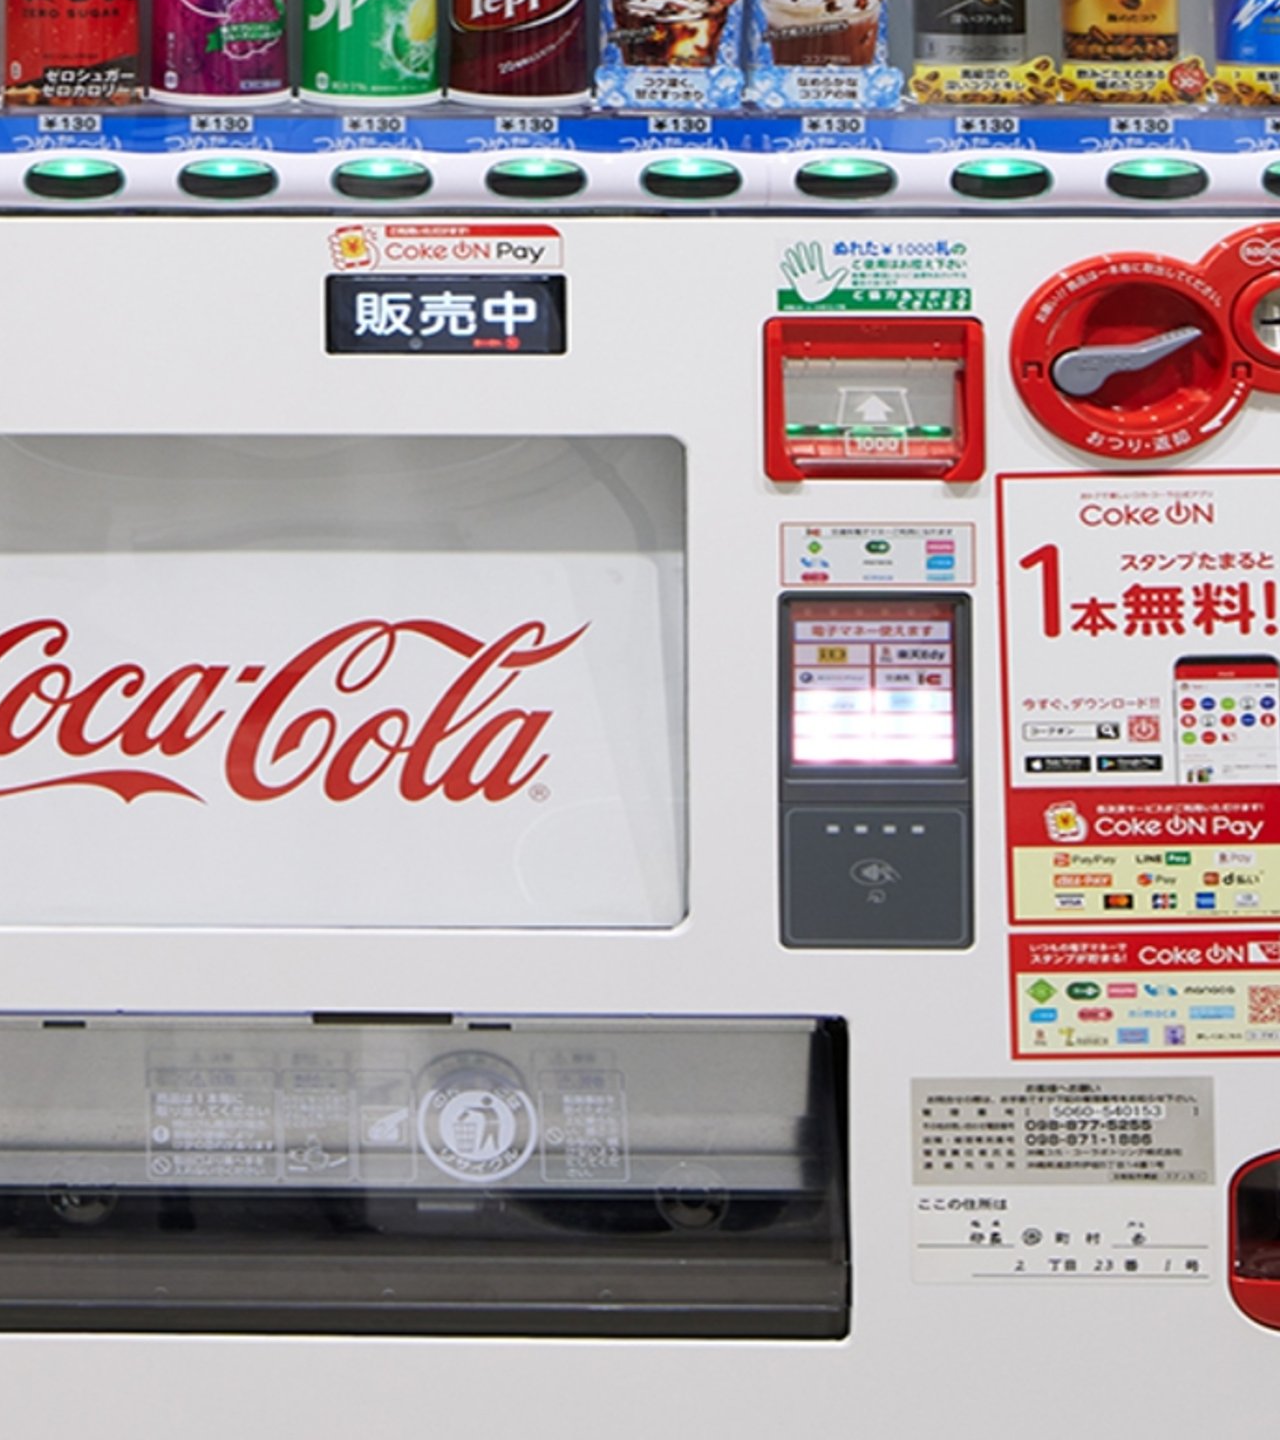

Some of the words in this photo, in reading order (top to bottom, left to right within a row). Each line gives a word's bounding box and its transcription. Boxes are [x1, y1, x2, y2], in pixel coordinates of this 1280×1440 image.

[45, 68, 135, 83] ゼロシュガー
[43, 117, 97, 131] ¥130
[195, 117, 248, 131] ¥130
[348, 118, 400, 132] ¥130
[500, 118, 553, 132] ¥130
[654, 118, 707, 132] ¥130
[806, 118, 860, 132] ¥130
[960, 118, 1014, 132] ¥130
[1115, 118, 1169, 132] ¥130
[385, 241, 448, 260] Coke
[452, 240, 492, 260] ON
[496, 241, 546, 264] Pay
[354, 290, 538, 337] 販売中
[1086, 432, 1192, 453] おつり・返却
[1079, 504, 1160, 526] Coke
[1166, 500, 1214, 525] ON
[1120, 550, 1275, 572] スタンプたまると
[1019, 543, 1279, 639] 1本無料!
[1094, 817, 1162, 836] Coke
[1165, 814, 1207, 835] ON
[1212, 817, 1265, 840] Pay
[1138, 946, 1201, 965] Coke
[1206, 944, 1245, 964] ON
[918, 1198, 1008, 1211] ここの住所は
